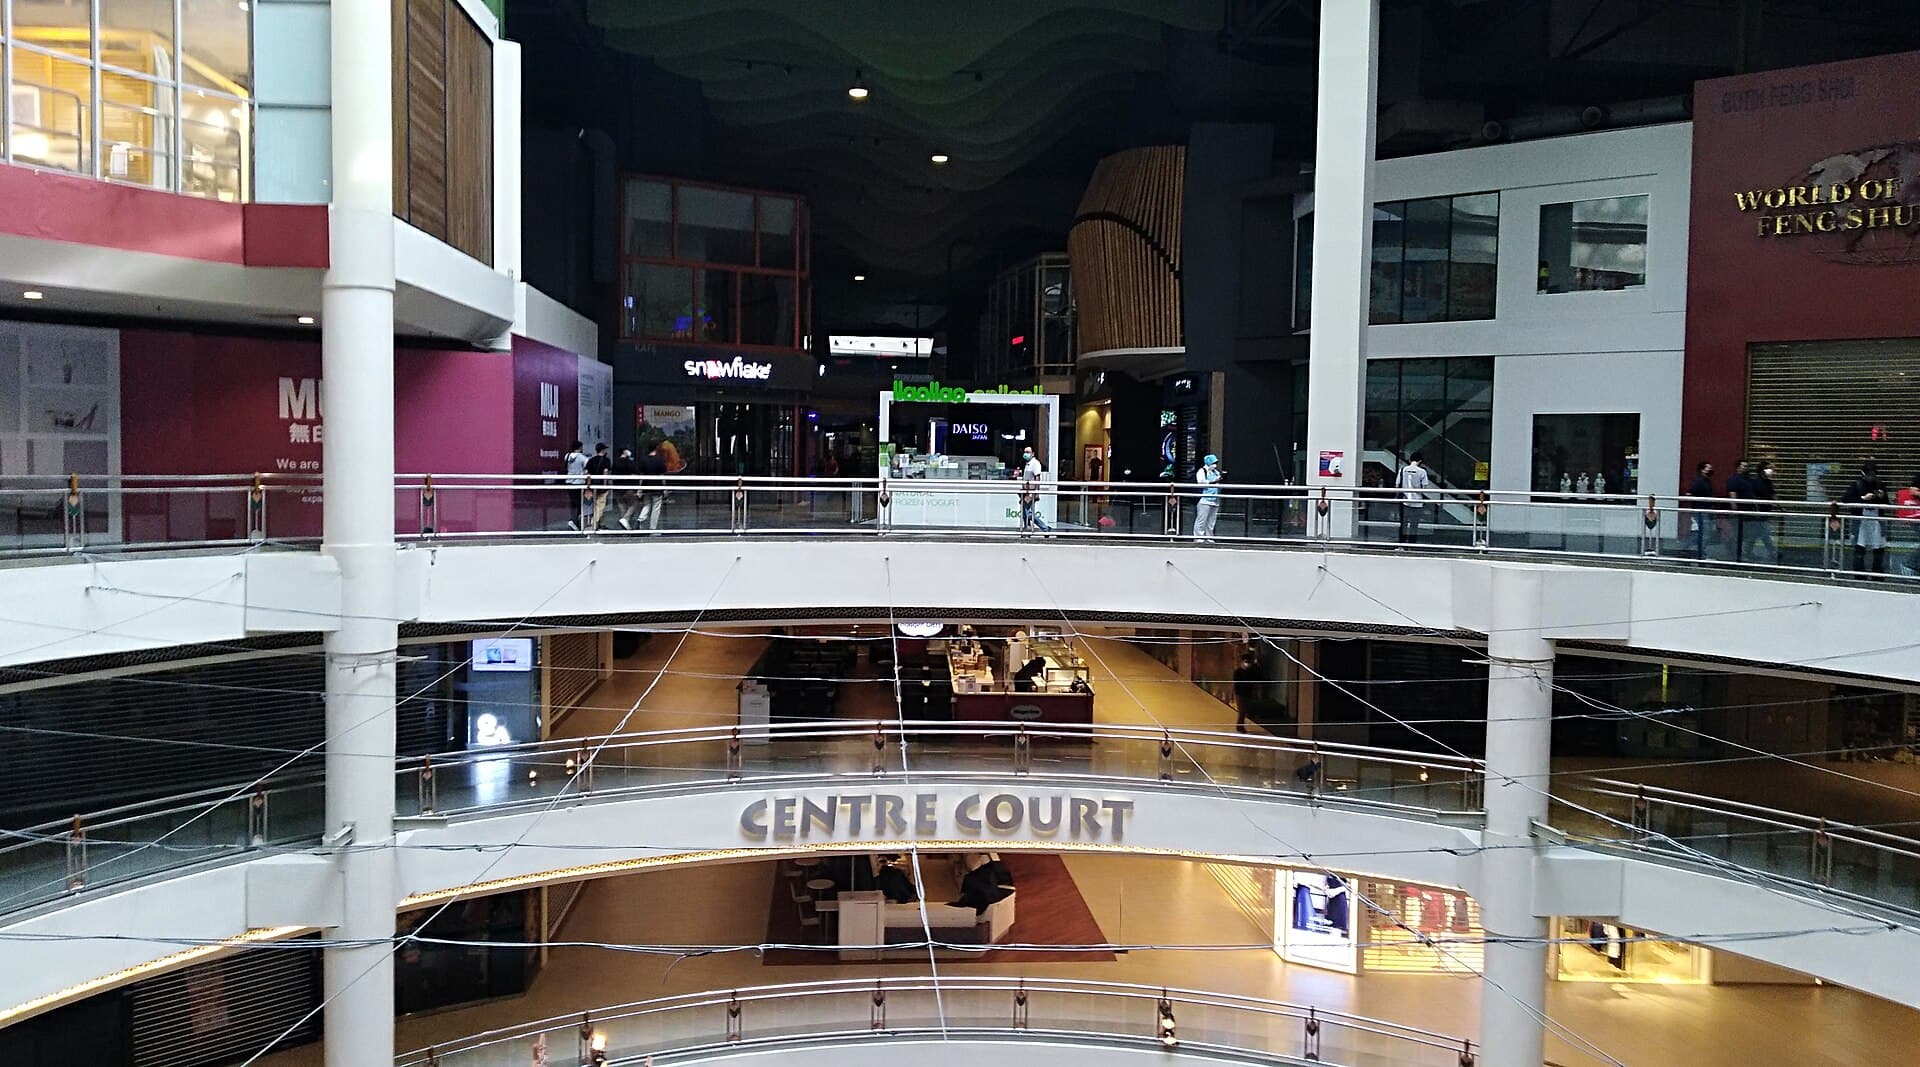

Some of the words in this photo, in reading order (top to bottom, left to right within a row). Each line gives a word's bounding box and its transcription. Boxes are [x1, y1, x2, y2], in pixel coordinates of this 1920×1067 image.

[1734, 182, 1851, 211] WORLD
[1860, 177, 1903, 200] OF
[1757, 211, 1836, 237] FENG
[1844, 203, 1920, 230] SHU
[540, 381, 559, 419] MUJI
[952, 423, 988, 435] DAISO
[276, 459, 297, 469] We
[299, 460, 319, 470] are
[740, 794, 938, 839] CENTRE
[954, 793, 1134, 839] COURT
